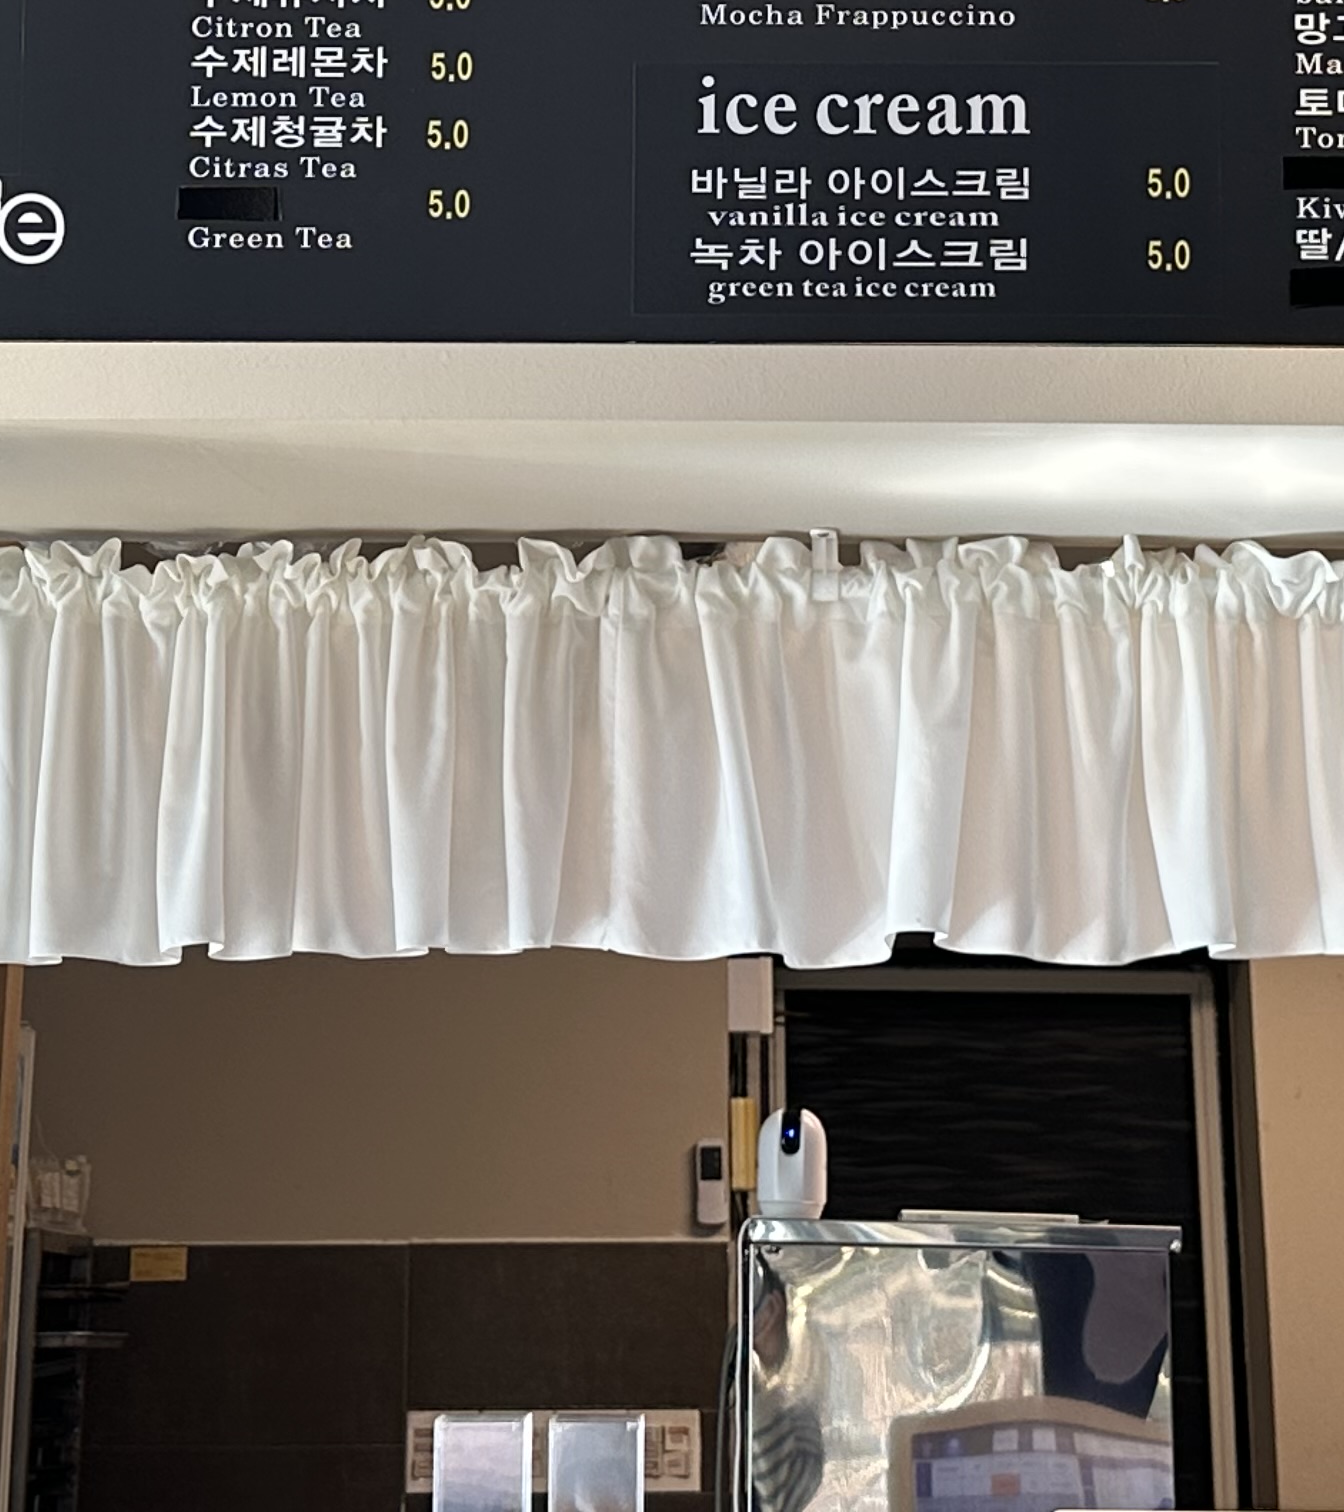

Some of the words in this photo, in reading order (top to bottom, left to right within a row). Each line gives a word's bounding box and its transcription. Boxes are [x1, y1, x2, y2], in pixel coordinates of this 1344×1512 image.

[190, 45, 389, 79] 수제레몬차
[697, 75, 798, 135] ice
[815, 93, 1031, 136] cream
[189, 115, 388, 149] 수제청귤차
[188, 155, 289, 179] Citras
[299, 155, 357, 179] Tea
[691, 166, 813, 201] 바닐라
[827, 166, 1030, 201] 아이스크림
[1147, 167, 1191, 200] 5.0
[707, 202, 830, 227] vanilla
[837, 204, 886, 227] ice
[894, 210, 999, 227] cream
[689, 237, 783, 271] 녹차
[799, 237, 1028, 271] 아이스크림
[707, 281, 794, 305] green
[801, 279, 848, 298] tea
[854, 276, 897, 298] ice
[904, 282, 996, 298] cream
